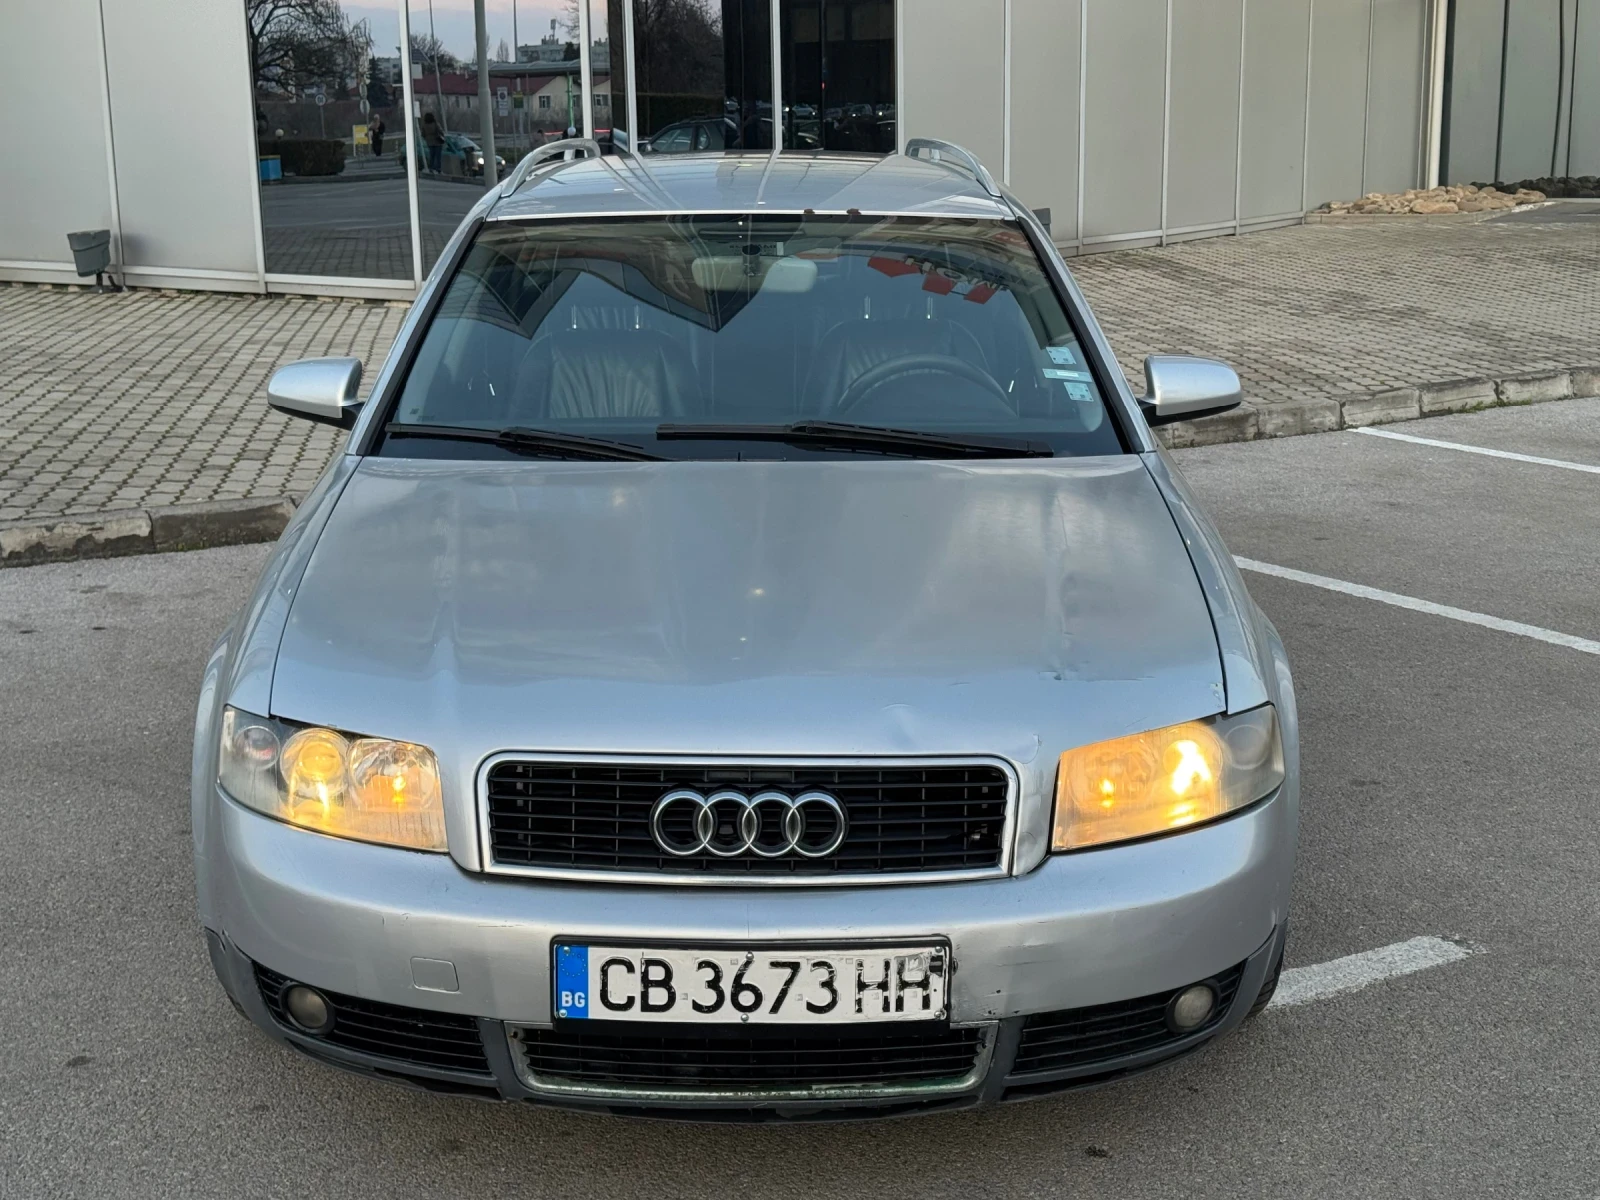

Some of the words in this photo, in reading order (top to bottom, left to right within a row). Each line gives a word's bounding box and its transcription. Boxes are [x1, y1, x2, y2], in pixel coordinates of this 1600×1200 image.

[561, 991, 586, 1008] BG
[600, 957, 676, 1012] CB
[691, 958, 839, 1014] 3673
[855, 958, 931, 1014] HH
